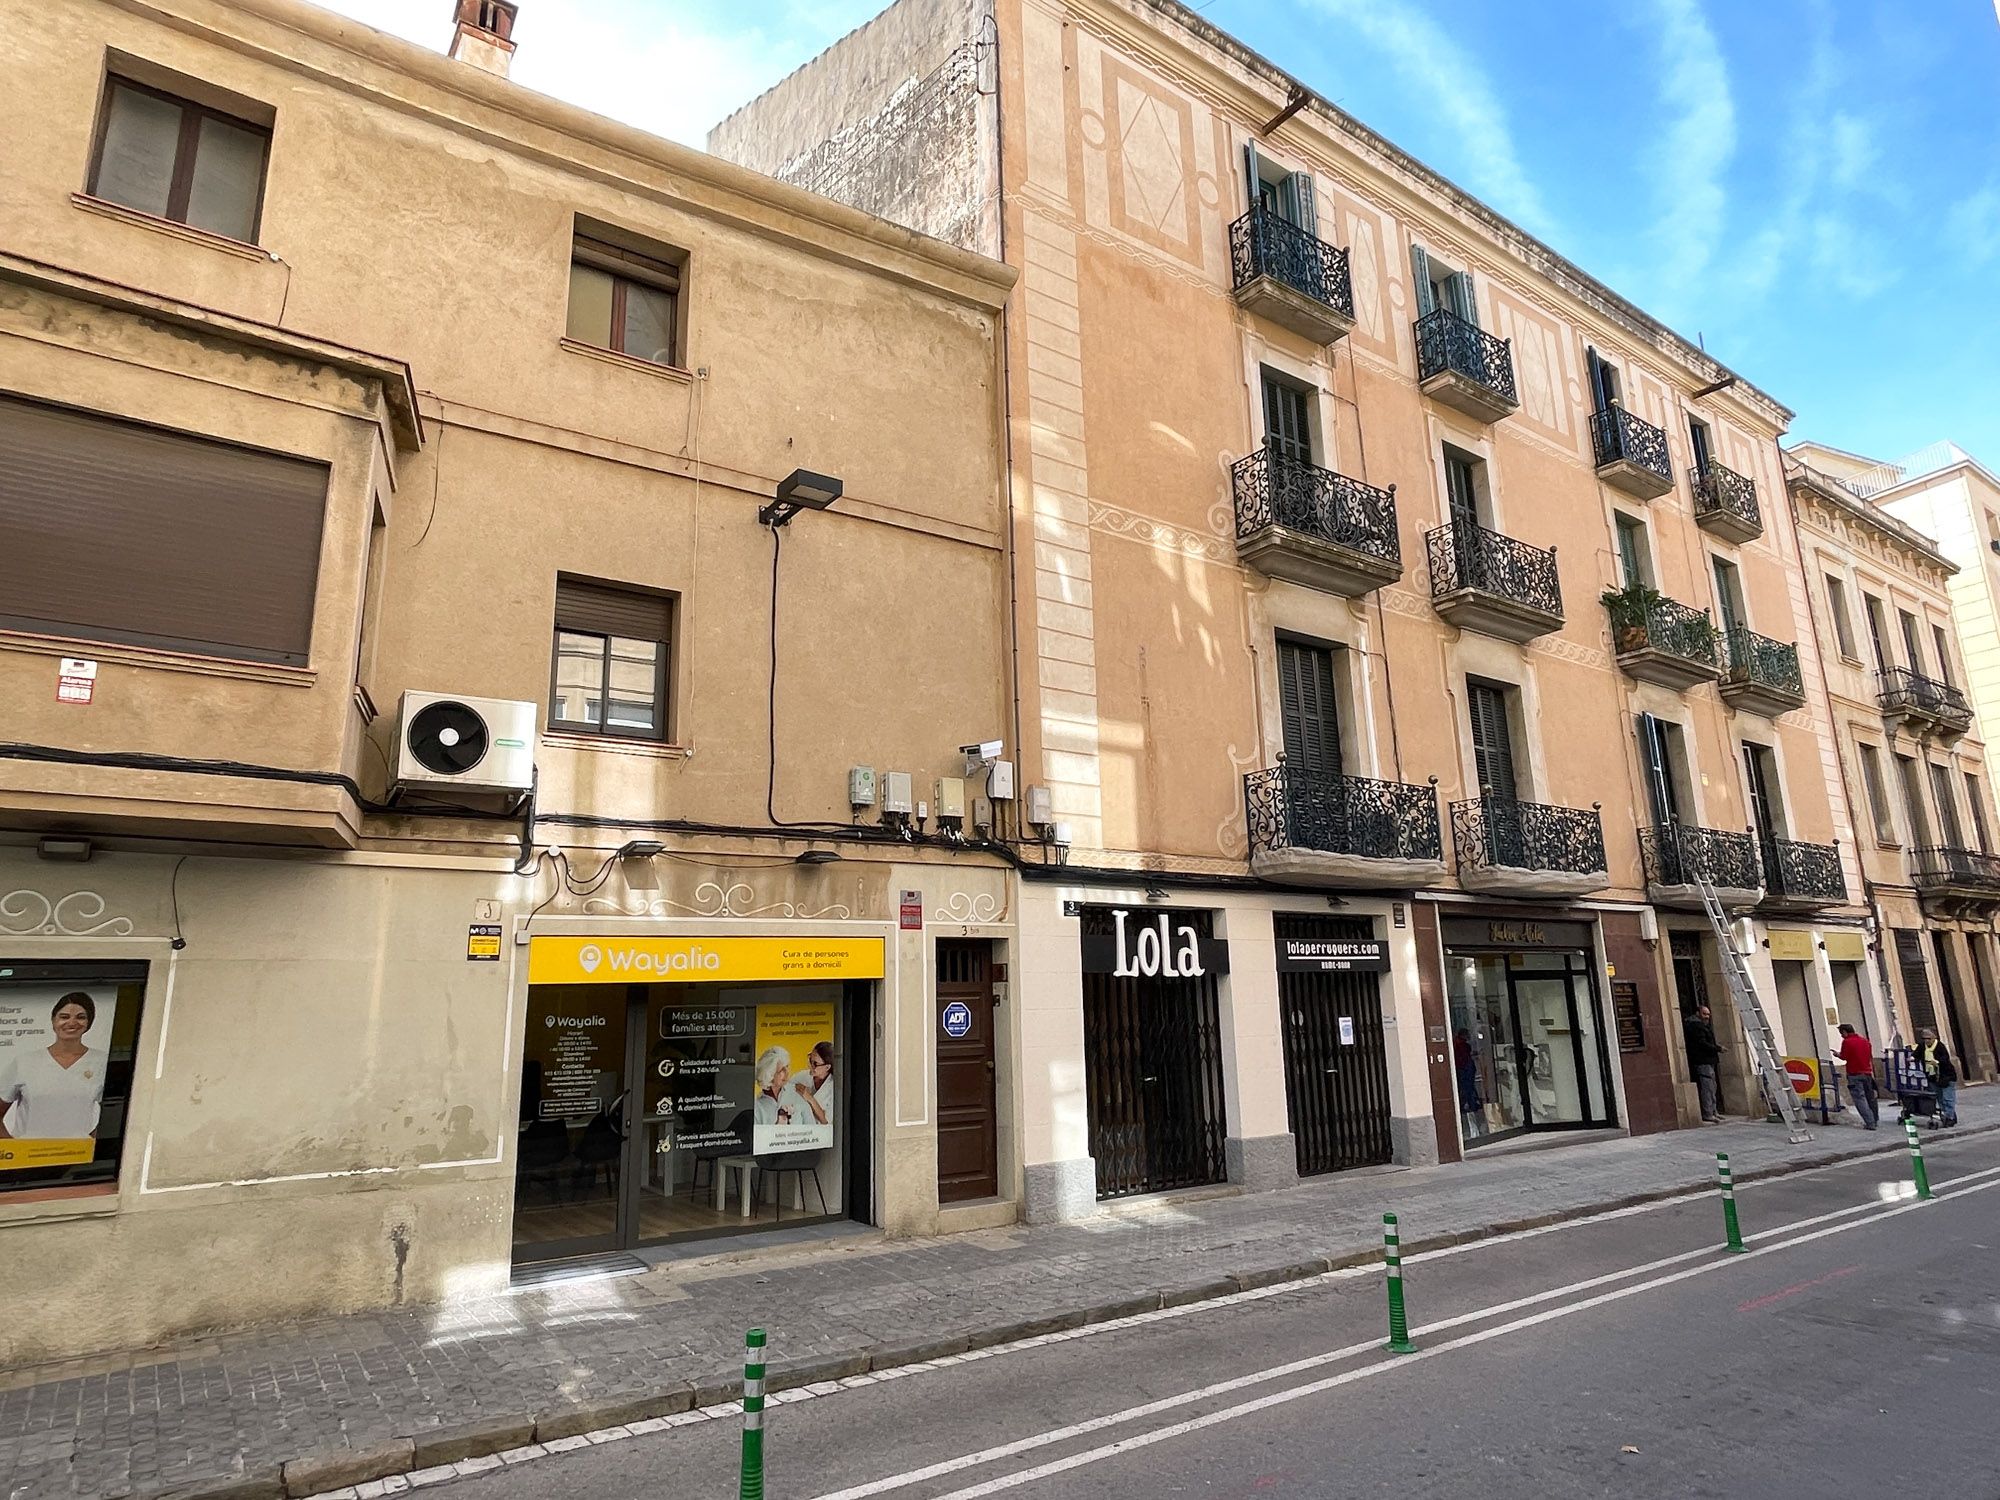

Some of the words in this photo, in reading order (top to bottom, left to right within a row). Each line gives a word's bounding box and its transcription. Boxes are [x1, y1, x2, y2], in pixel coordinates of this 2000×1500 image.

[1068, 901, 1075, 911] 3
[961, 925, 968, 936] 3
[1112, 910, 1206, 977] Lola
[1286, 941, 1380, 955] lolaperruquers.com
[782, 950, 801, 958] Cura
[815, 951, 849, 959] persones
[608, 946, 720, 976] Wayalia
[783, 962, 804, 971] grans
[813, 961, 842, 969] domicili
[672, 1011, 690, 1020] Més
[692, 1011, 703, 1020] de
[705, 1010, 736, 1020] 15.000
[949, 1012, 966, 1024] ADT
[557, 1015, 606, 1028] Wayalia
[707, 1023, 735, 1032] ateses
